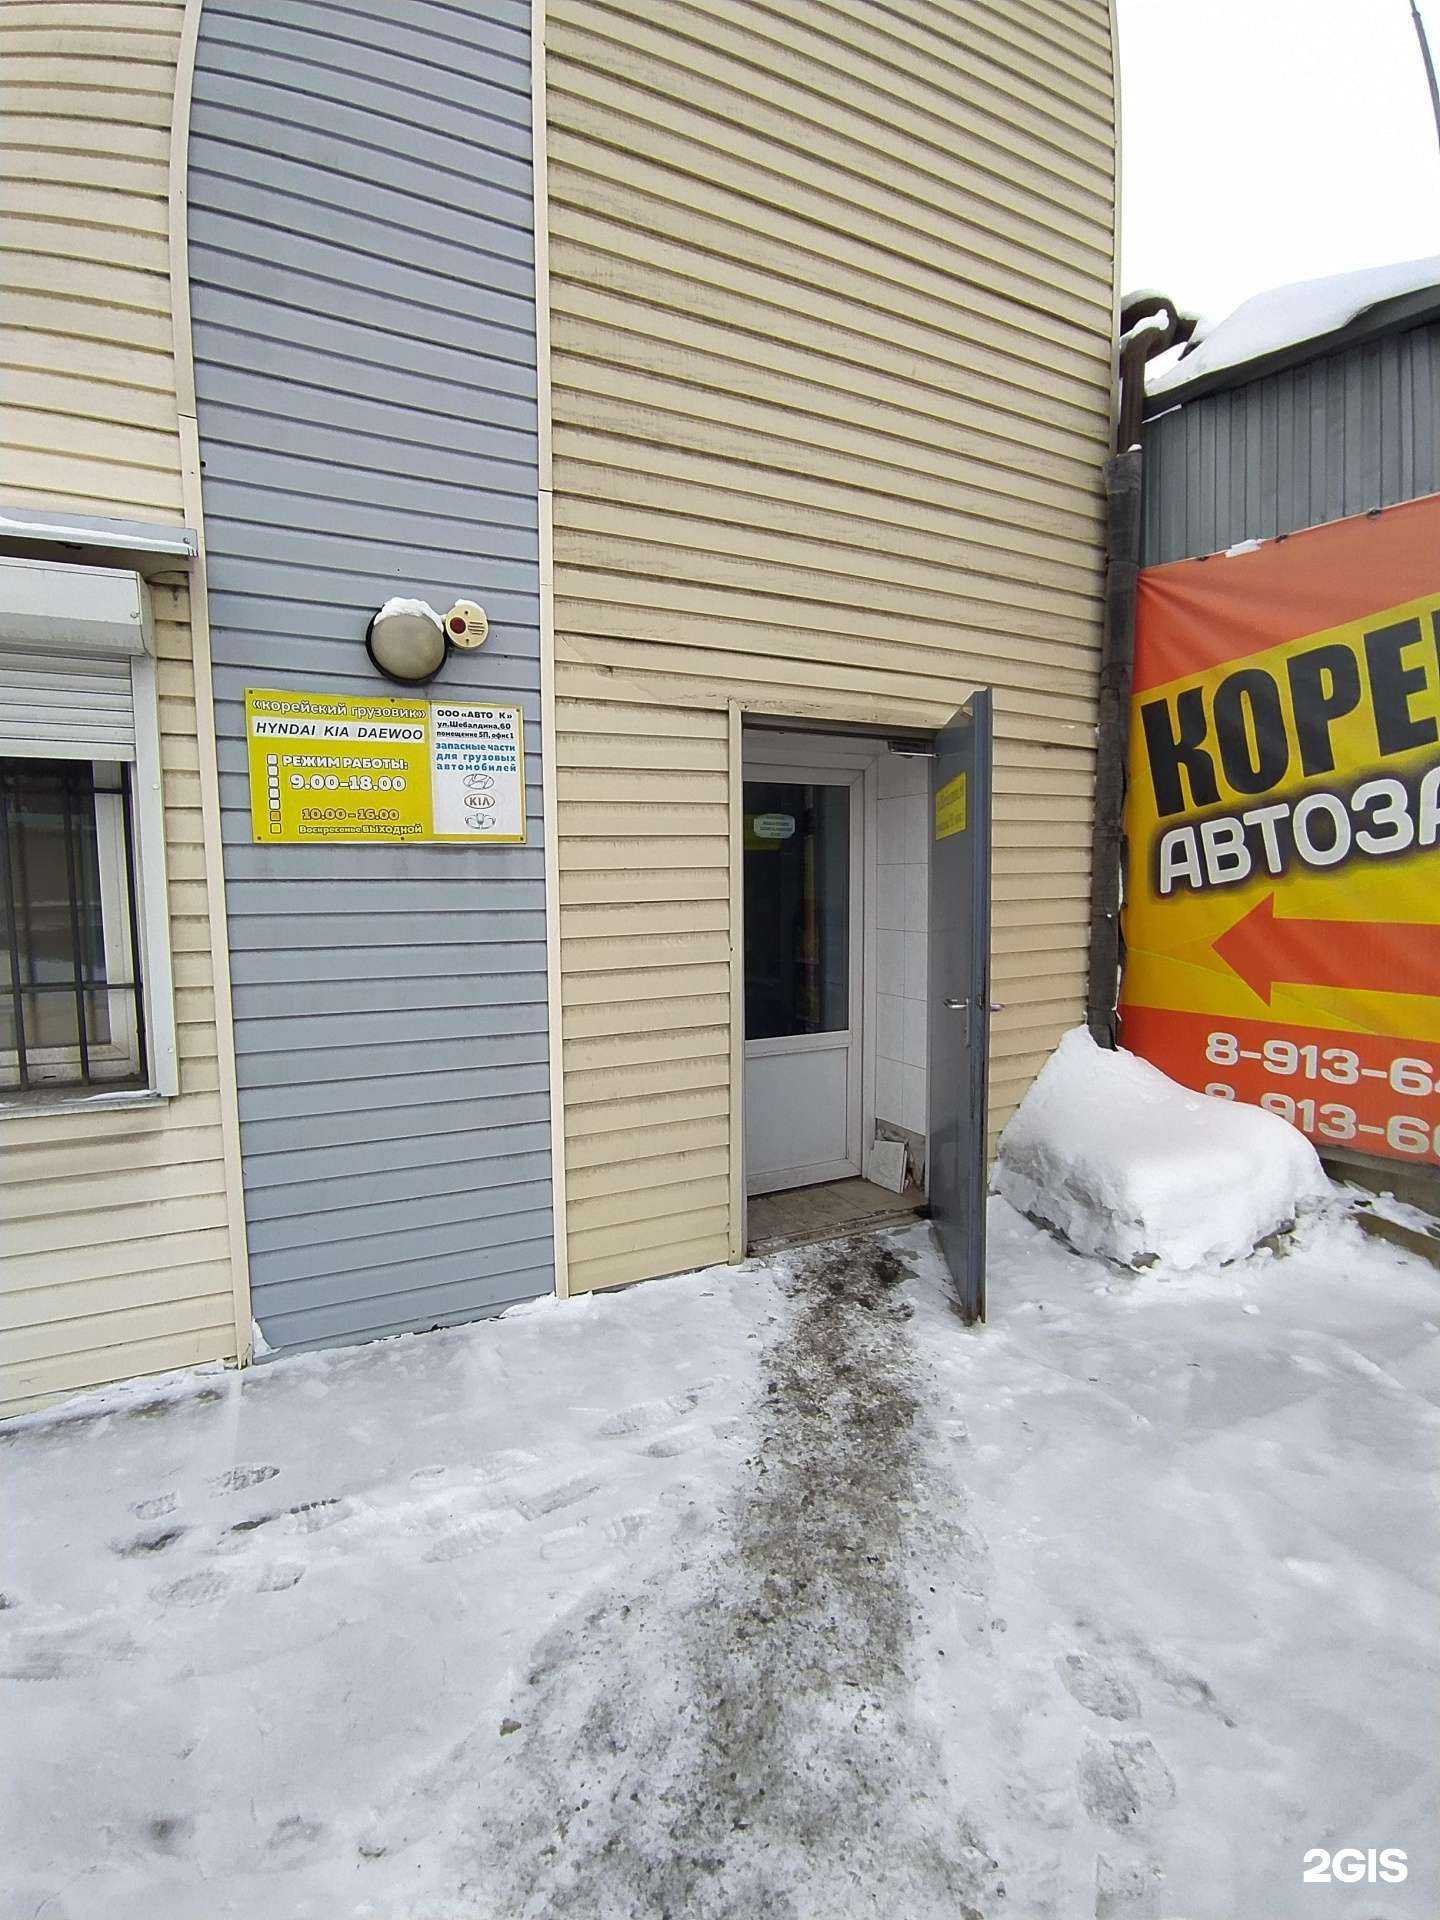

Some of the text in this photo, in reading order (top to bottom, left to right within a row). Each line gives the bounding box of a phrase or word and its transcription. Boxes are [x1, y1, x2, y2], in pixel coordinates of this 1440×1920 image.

[252, 699, 427, 719] «корейский грузовик»
[1141, 609, 1440, 817] КОРЕ
[256, 722, 423, 740] HYNDAI KIA DAEWOO
[435, 742, 516, 752] запасные части
[282, 754, 409, 770] РЕЖИМ РАБОТЫ:
[436, 753, 516, 763] для грузовых
[436, 763, 517, 772] автомобилей
[1205, 1032, 1440, 1097] 8-913-6
